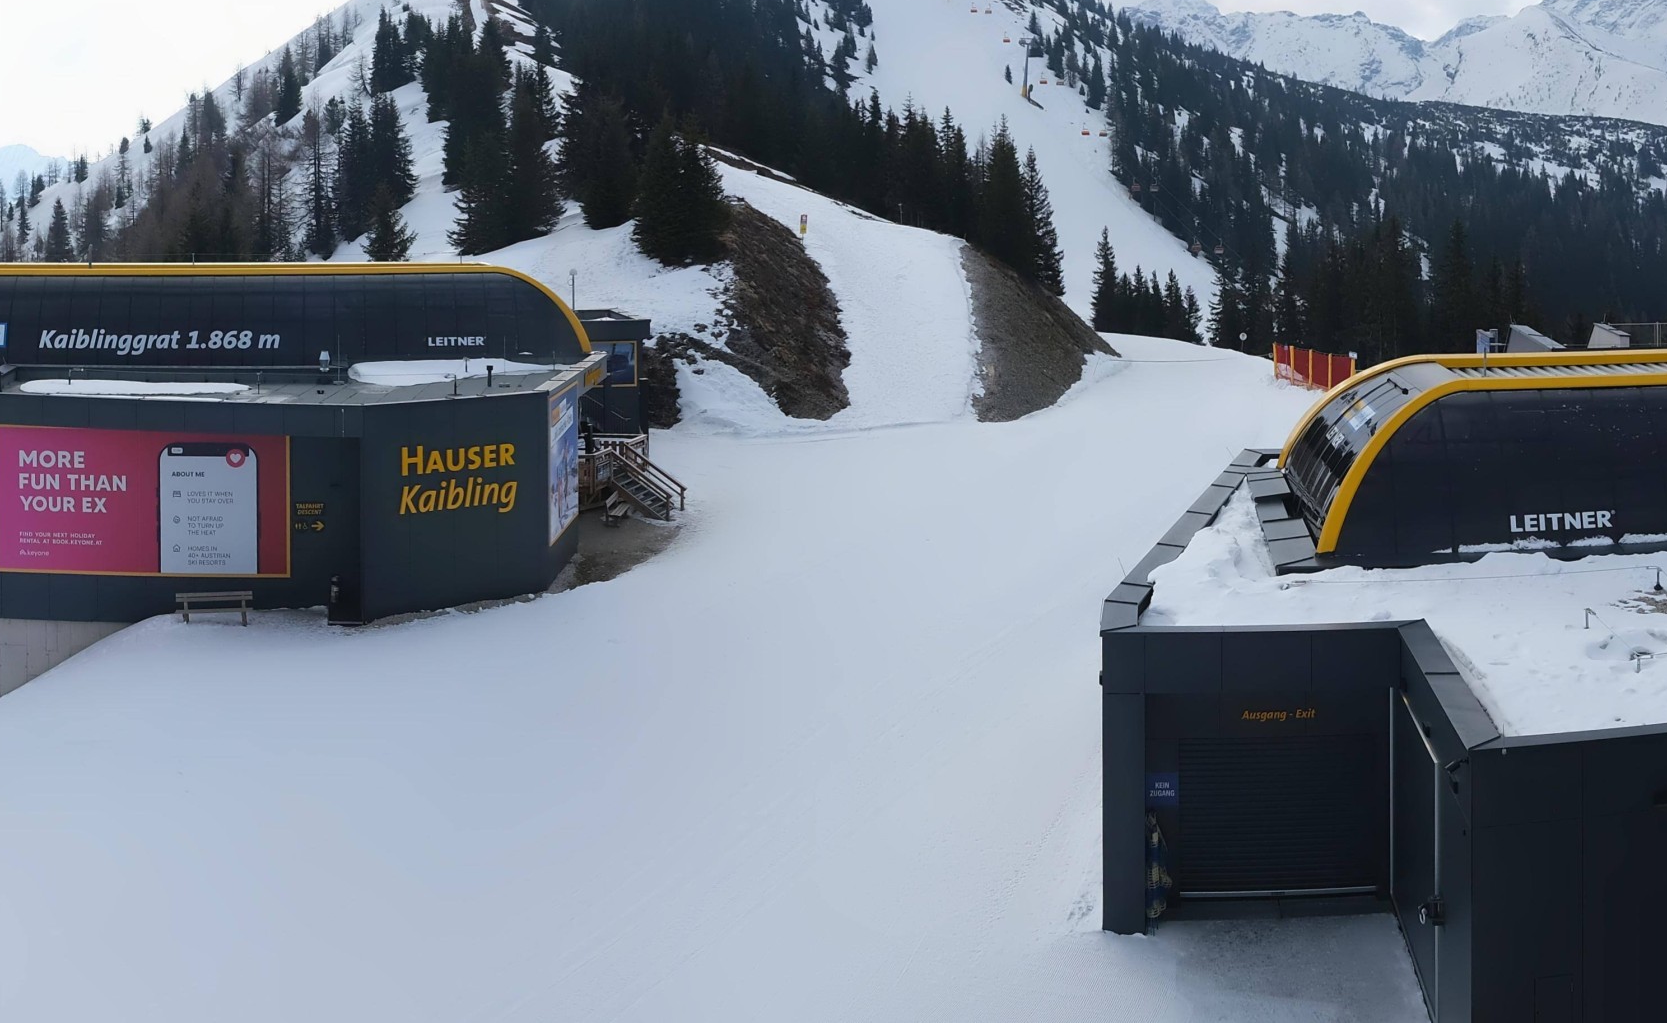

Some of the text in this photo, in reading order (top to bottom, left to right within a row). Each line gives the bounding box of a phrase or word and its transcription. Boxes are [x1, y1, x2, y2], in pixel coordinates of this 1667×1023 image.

[38, 329, 280, 355] Kaiblinggrat 1.868 m
[428, 336, 485, 346] LEITNER
[19, 450, 85, 468] MORE
[401, 443, 515, 476] HAUSER
[19, 473, 127, 491] FUN THAN
[20, 496, 107, 513] YOUR EX
[399, 477, 518, 515] Kaibling
[1510, 511, 1616, 533] LEITNER
[1241, 710, 1287, 722] Ausgang
[1295, 708, 1316, 718] Exit
